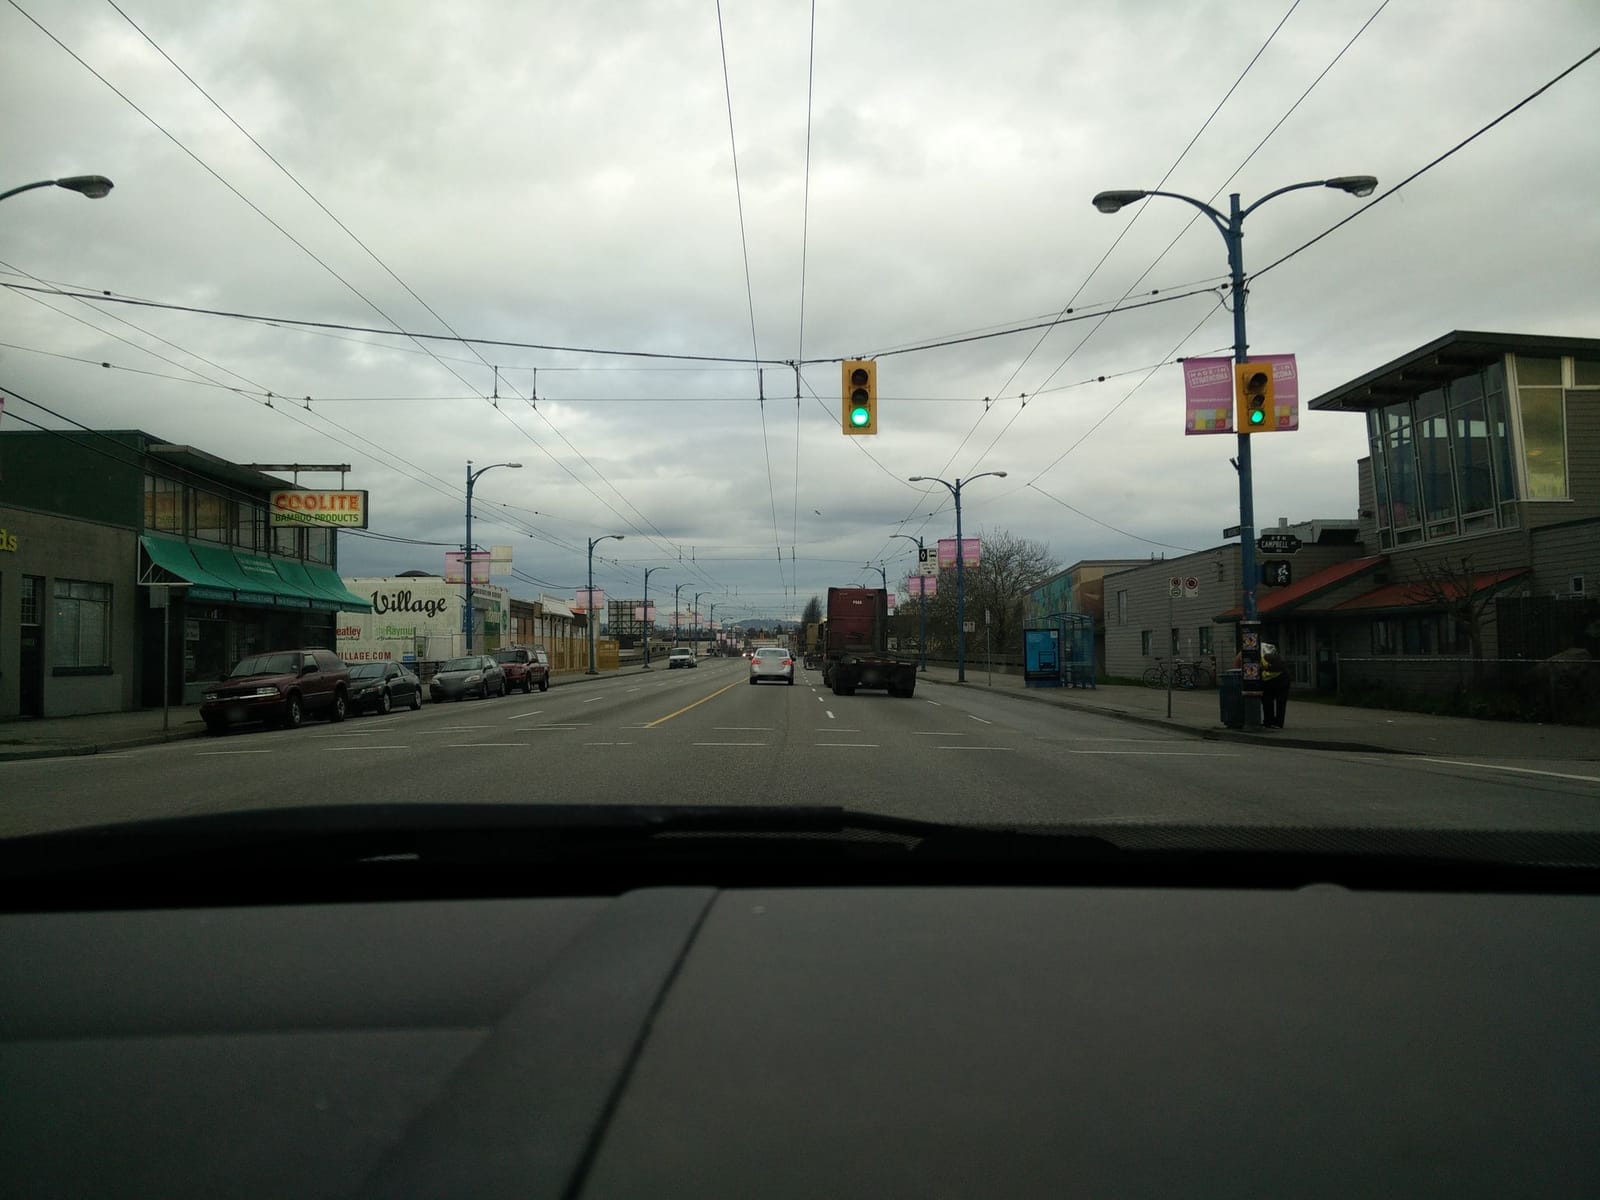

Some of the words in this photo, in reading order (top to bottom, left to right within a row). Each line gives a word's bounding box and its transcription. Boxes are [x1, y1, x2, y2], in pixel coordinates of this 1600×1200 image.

[274, 493, 360, 511] COOLITE
[275, 513, 312, 522] BAMBOO
[315, 513, 359, 522] PRODUCTS
[371, 590, 447, 618] Village
[336, 626, 361, 638] eatley
[385, 625, 414, 636] Raymu
